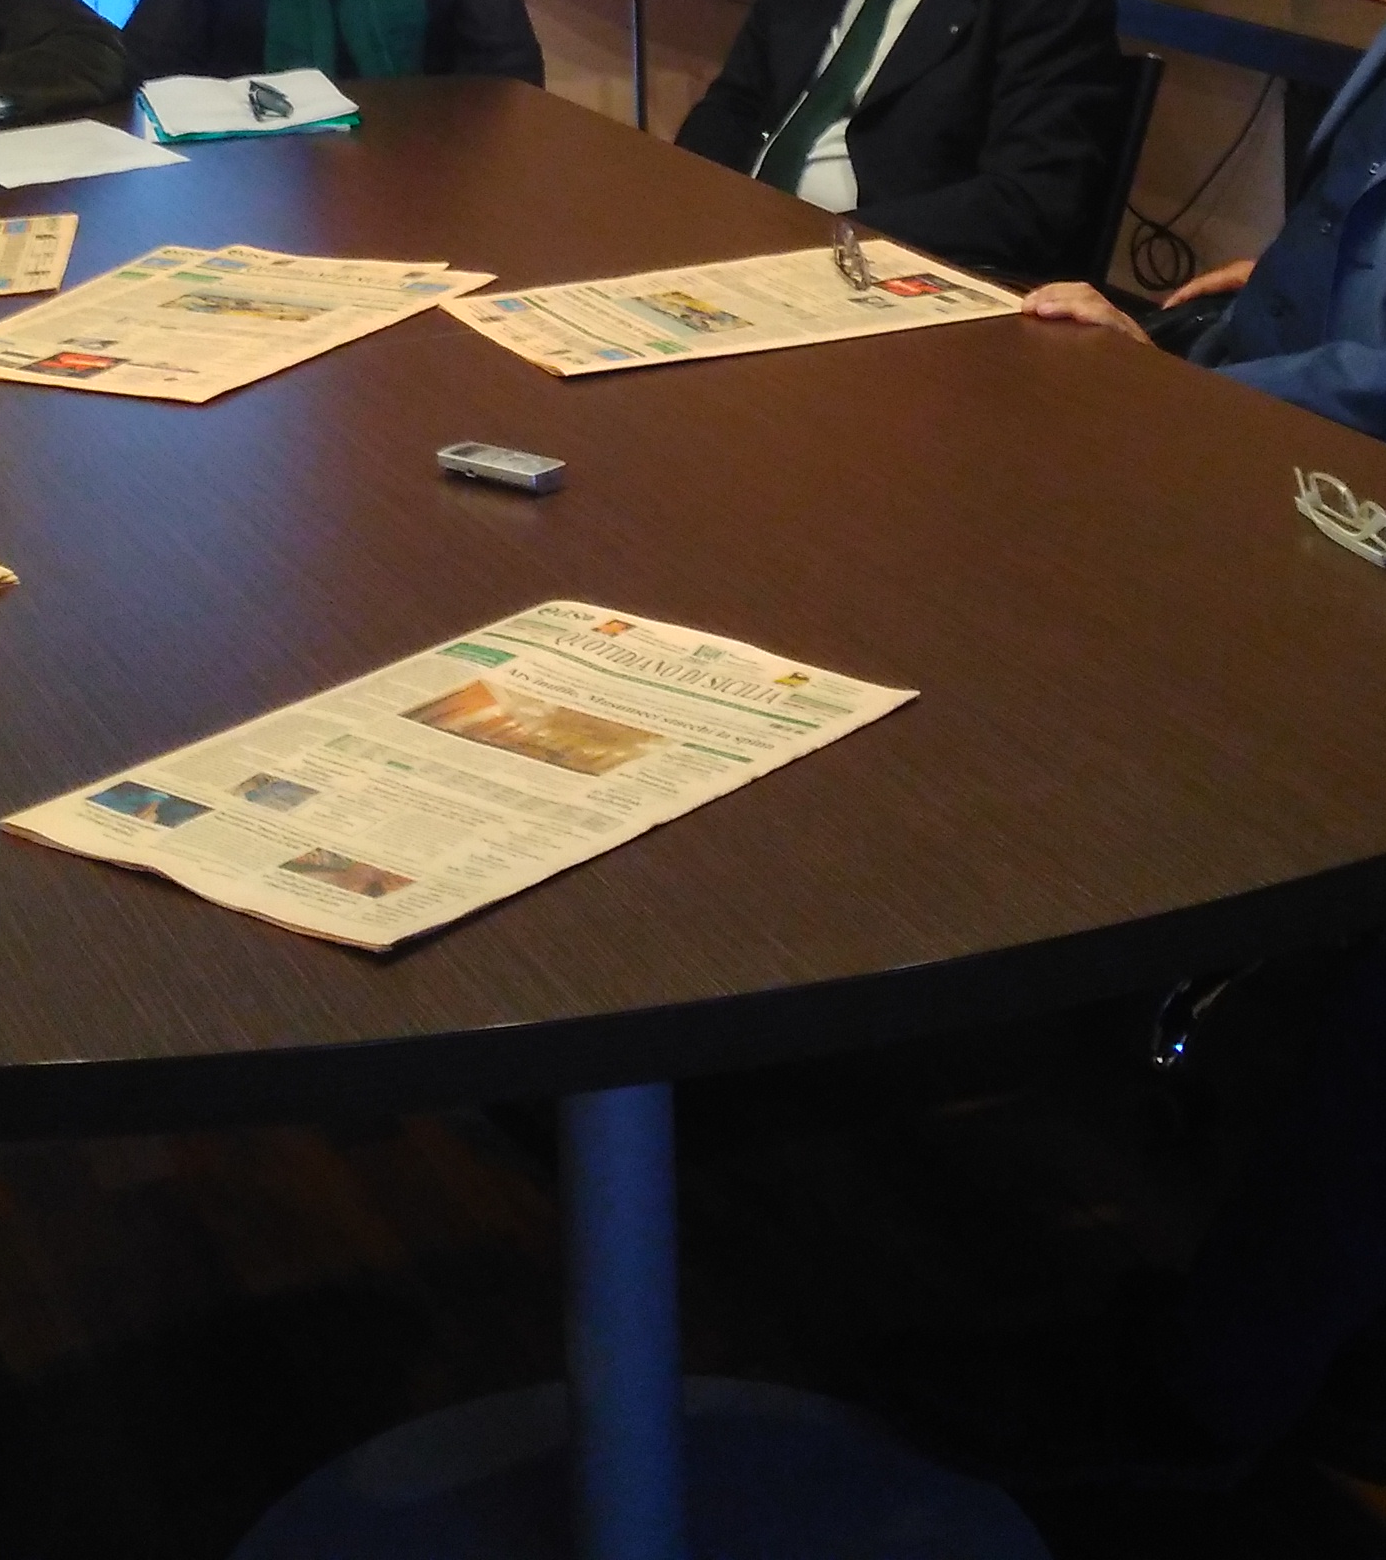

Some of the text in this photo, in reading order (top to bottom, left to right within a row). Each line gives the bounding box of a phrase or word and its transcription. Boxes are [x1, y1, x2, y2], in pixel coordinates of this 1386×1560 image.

[555, 631, 782, 705] QUOTIDIANO DI SICILIA
